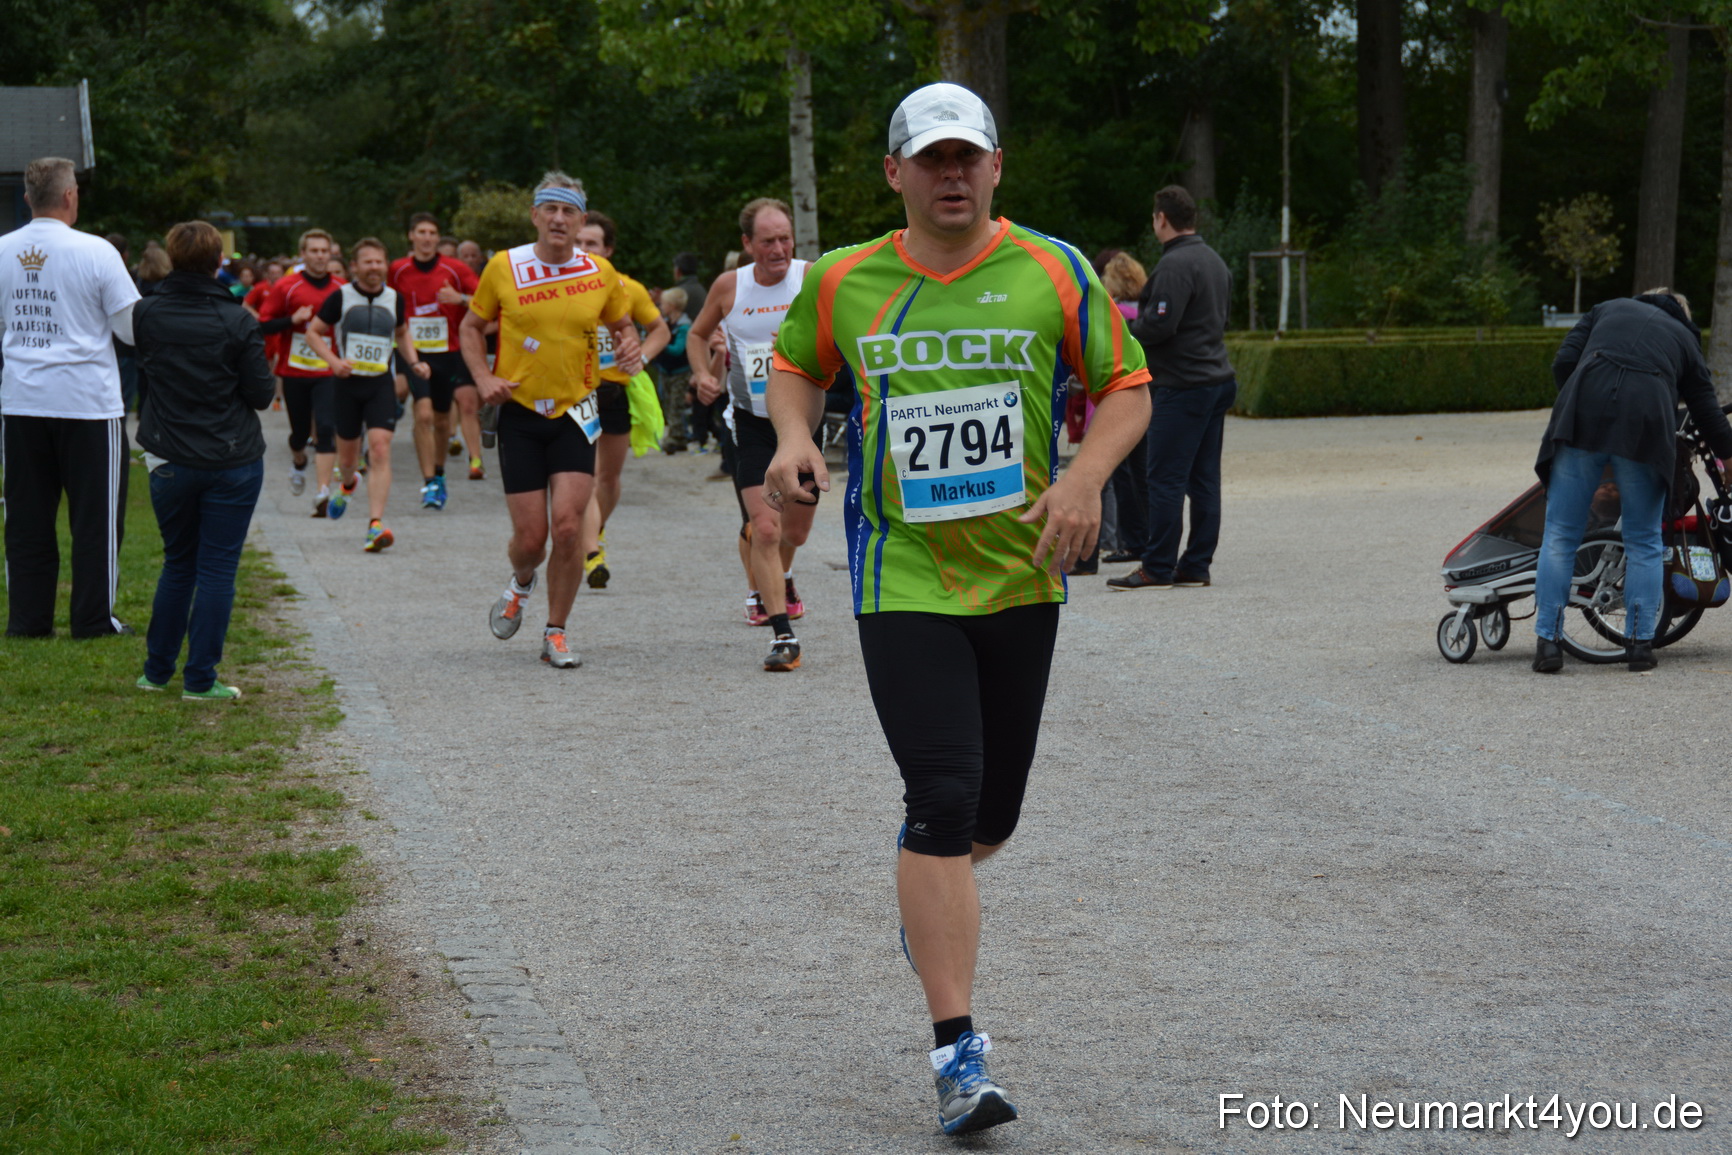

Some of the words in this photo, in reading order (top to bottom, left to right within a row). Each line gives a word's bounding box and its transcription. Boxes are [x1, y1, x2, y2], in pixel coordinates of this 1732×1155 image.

[26, 272, 39, 283] IM
[518, 288, 560, 306] MAX
[565, 278, 606, 296] BÖGL
[15, 304, 52, 317] SEINER
[415, 326, 440, 339] 289
[21, 336, 51, 349] JESUS
[354, 344, 382, 361] 360
[856, 329, 1037, 376] BOCK
[890, 406, 932, 421] PARTL
[934, 397, 999, 416] Neumarkt
[904, 414, 1013, 472] 2794
[930, 480, 996, 502] Markus
